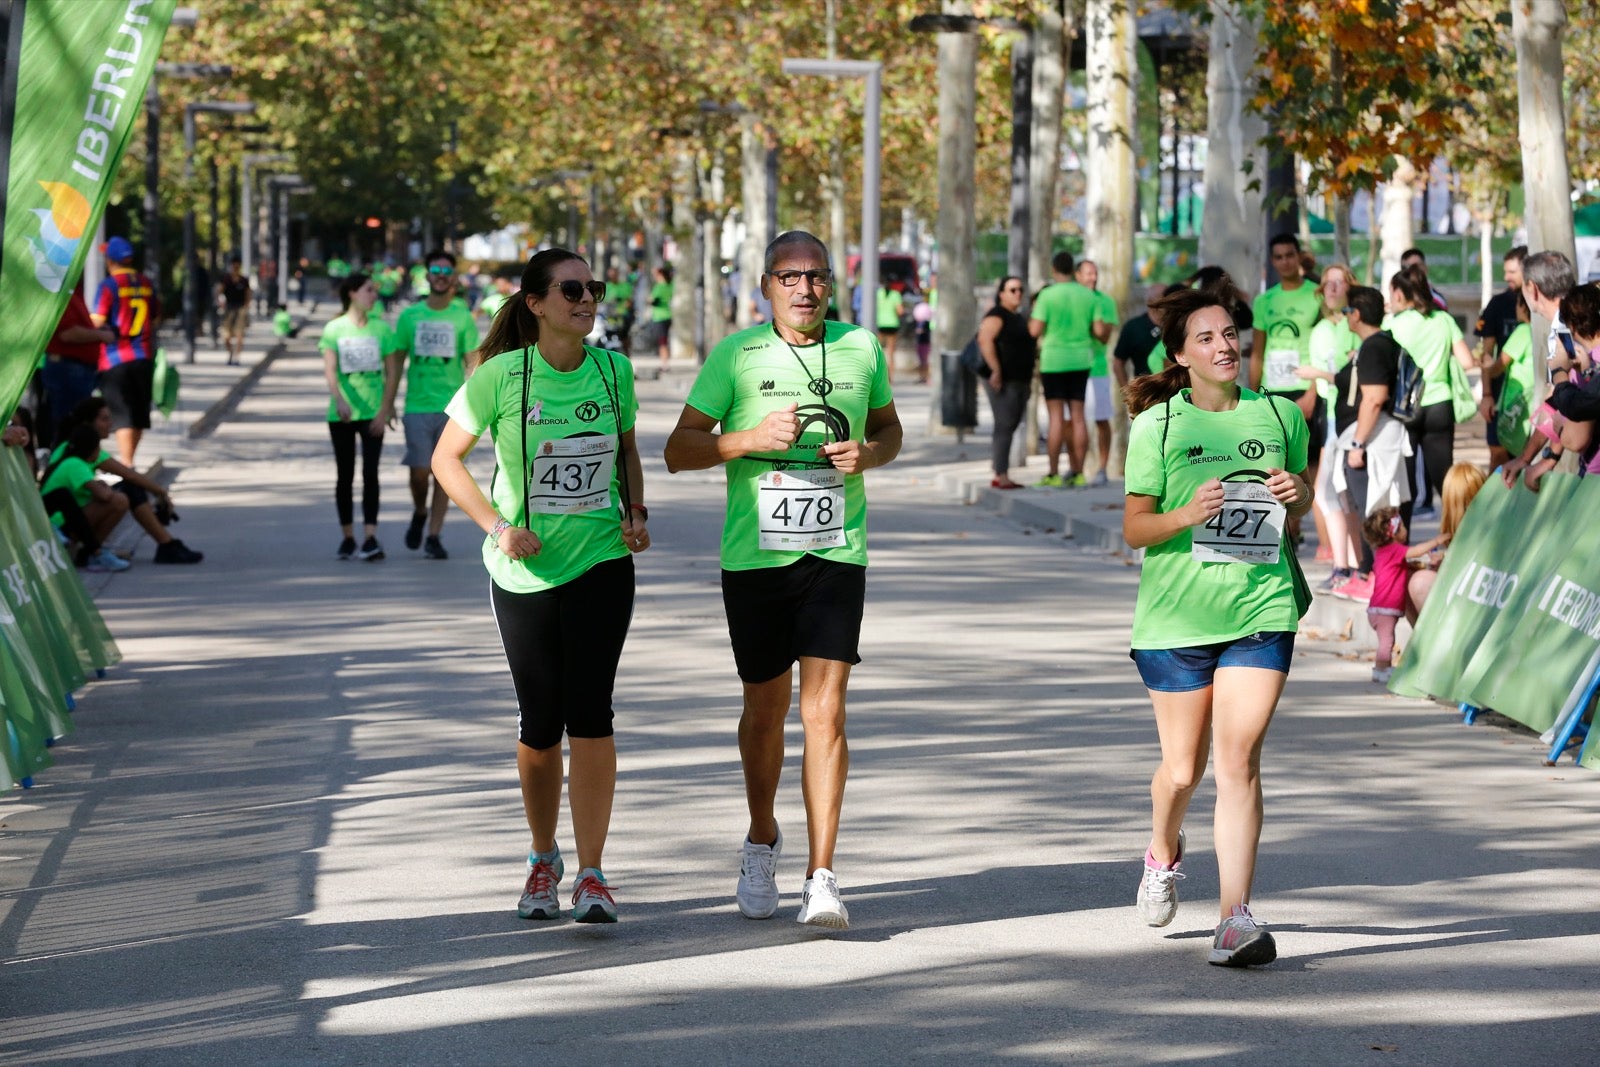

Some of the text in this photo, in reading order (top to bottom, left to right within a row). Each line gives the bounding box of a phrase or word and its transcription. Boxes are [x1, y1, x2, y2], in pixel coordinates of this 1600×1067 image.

[129, 298, 148, 337] 7
[1190, 455, 1232, 465] IBERDROLA
[540, 461, 602, 492] 437
[772, 496, 833, 527] 478
[1205, 508, 1271, 539] 427
